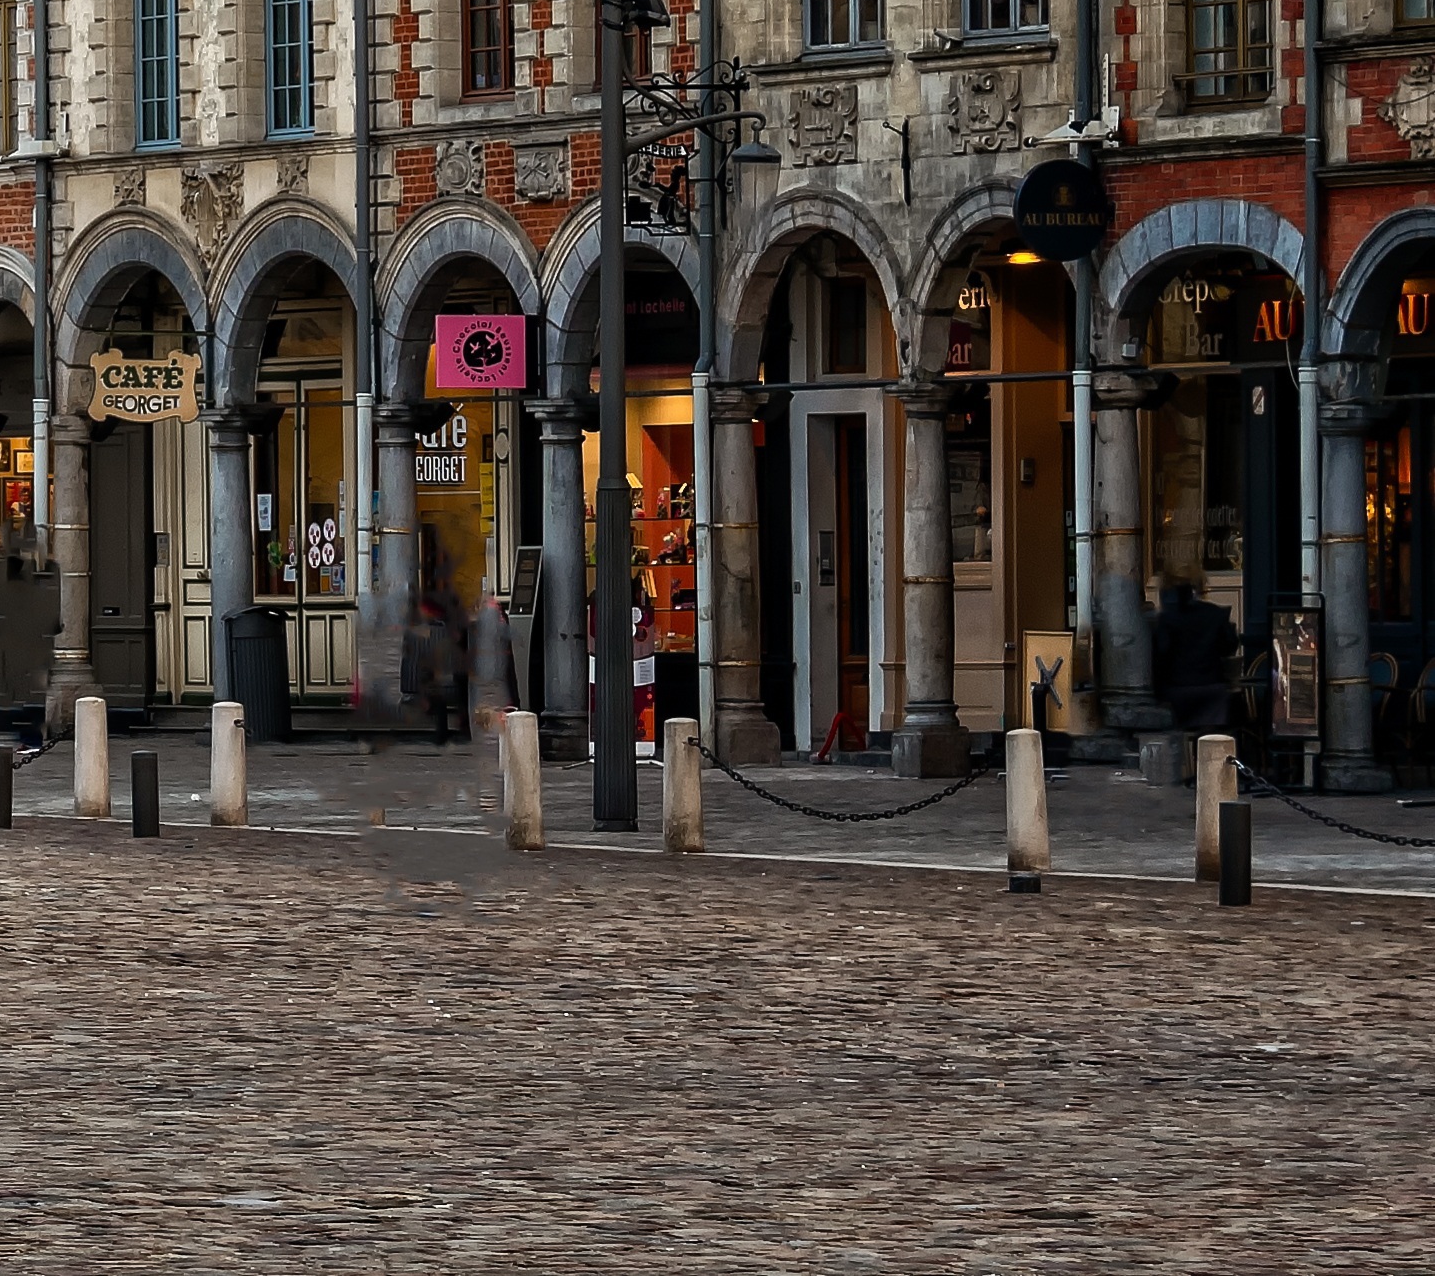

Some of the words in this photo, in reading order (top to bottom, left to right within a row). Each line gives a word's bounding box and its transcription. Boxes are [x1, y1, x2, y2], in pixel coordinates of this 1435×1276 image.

[1023, 212, 1041, 226] AU
[1046, 212, 1105, 226] BUREAU
[626, 302, 636, 314] nt
[1184, 320, 1224, 357] Bar
[100, 358, 184, 389] CAFÉ
[102, 394, 181, 415] GEORGET
[415, 456, 467, 482] EORGET
